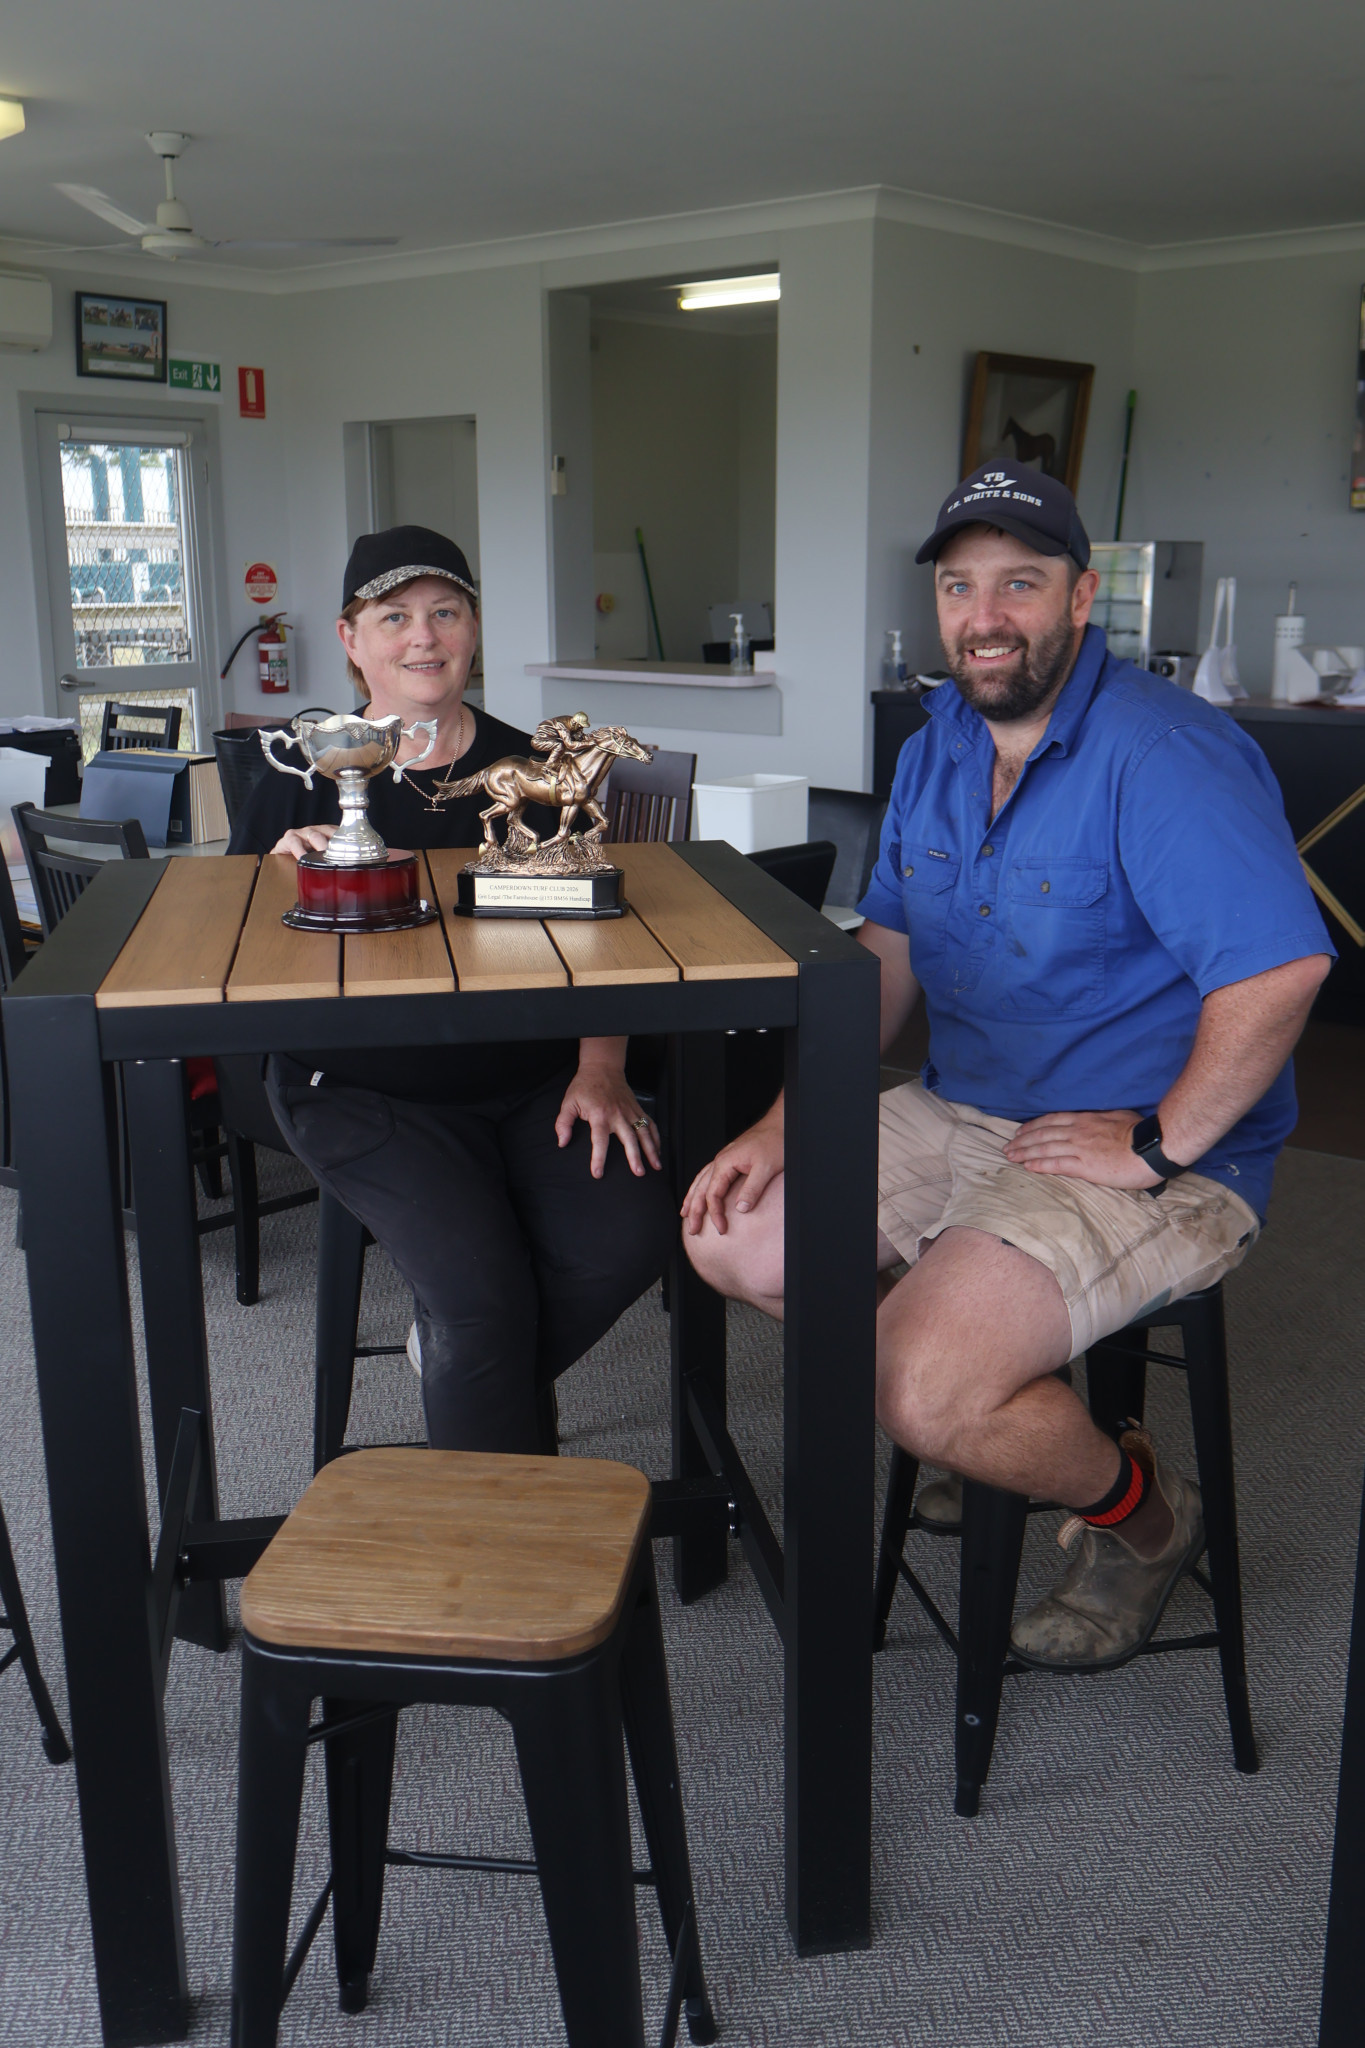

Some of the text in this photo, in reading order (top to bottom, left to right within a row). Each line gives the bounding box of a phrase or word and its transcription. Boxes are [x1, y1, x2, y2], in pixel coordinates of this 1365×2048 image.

[172, 367, 188, 381] Exit
[983, 472, 1006, 483] TB
[963, 490, 1001, 503] WHITE
[1002, 490, 1011, 498] &
[1012, 491, 1043, 507] SONS
[569, 895, 591, 903] Handicap
